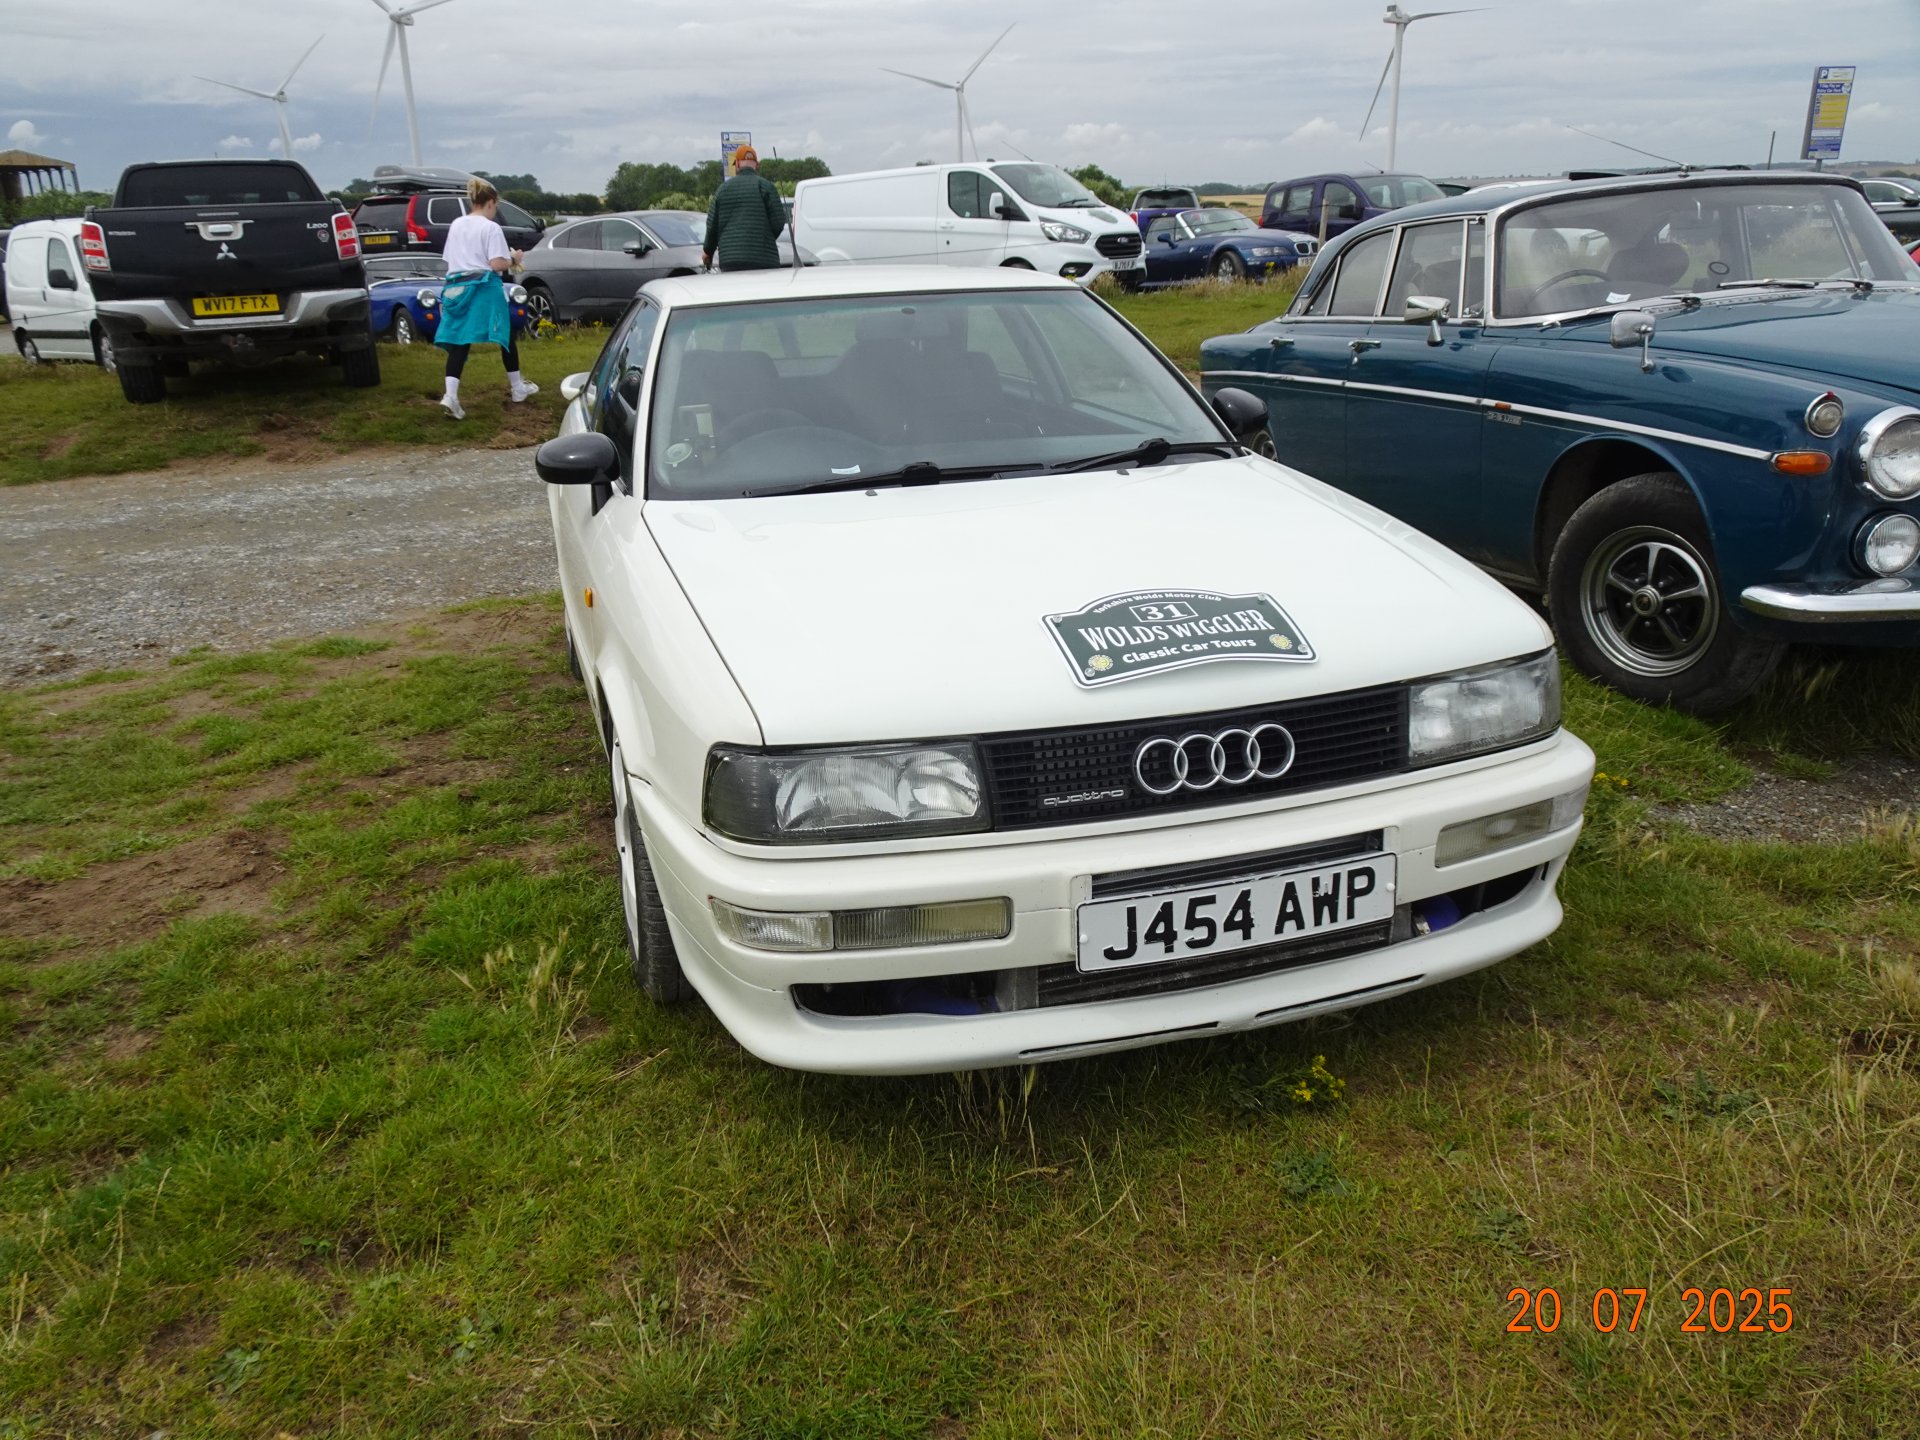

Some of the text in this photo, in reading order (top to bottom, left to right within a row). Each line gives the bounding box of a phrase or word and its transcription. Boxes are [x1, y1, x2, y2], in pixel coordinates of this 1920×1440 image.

[202, 296, 270, 312] WV17 FTX
[1093, 597, 1134, 614] Yorkshire
[1133, 593, 1164, 601] Wolds
[1198, 594, 1222, 602] Club
[1140, 604, 1188, 620] 31
[1078, 609, 1275, 651] WOLDS WIGGLER
[1122, 646, 1179, 664] Classic
[1181, 642, 1209, 653] Car
[1211, 638, 1257, 649] Tours
[1043, 789, 1125, 807] quattro
[1103, 865, 1377, 961] J454 AWP
